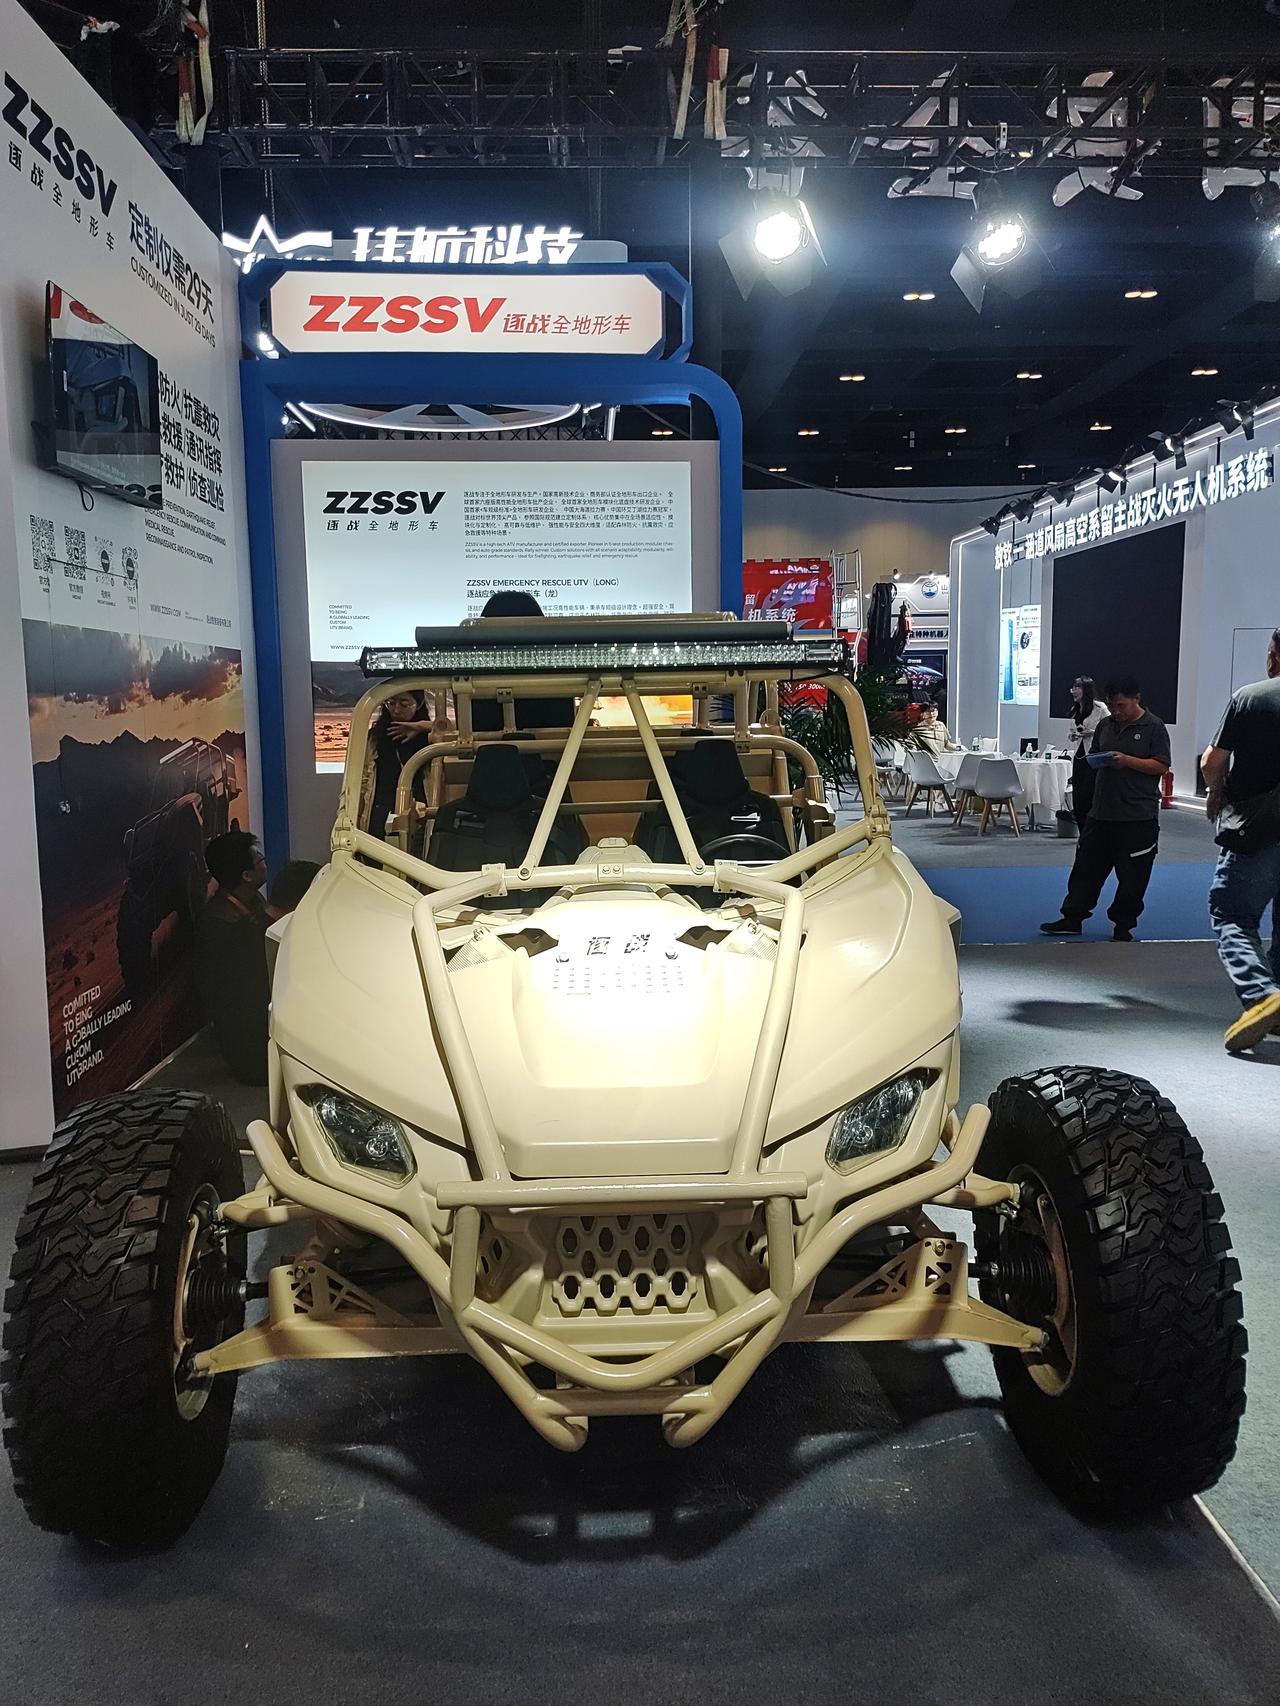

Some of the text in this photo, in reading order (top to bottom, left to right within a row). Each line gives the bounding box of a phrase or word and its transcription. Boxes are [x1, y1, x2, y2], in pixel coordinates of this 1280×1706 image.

[1, 71, 118, 218] ZZSSV
[8, 140, 115, 252] 逐战全地形车
[128, 199, 215, 325] 定制仅需29天
[130, 256, 216, 348] CUSTOMIZED IN JUST 29 DAYS
[302, 295, 633, 336] ZZSSV 逐战全地形车
[322, 490, 446, 515] ZZSSV
[327, 520, 439, 531] 逐战全地形车
[466, 579, 491, 587] ZZSSV
[492, 579, 540, 587] EMERGENCY
[541, 579, 572, 587] RESCUE
[573, 579, 589, 587] UTV
[63, 1019, 75, 1036] TO
[65, 1039, 72, 1054] A
[103, 999, 132, 1026] LEADING
